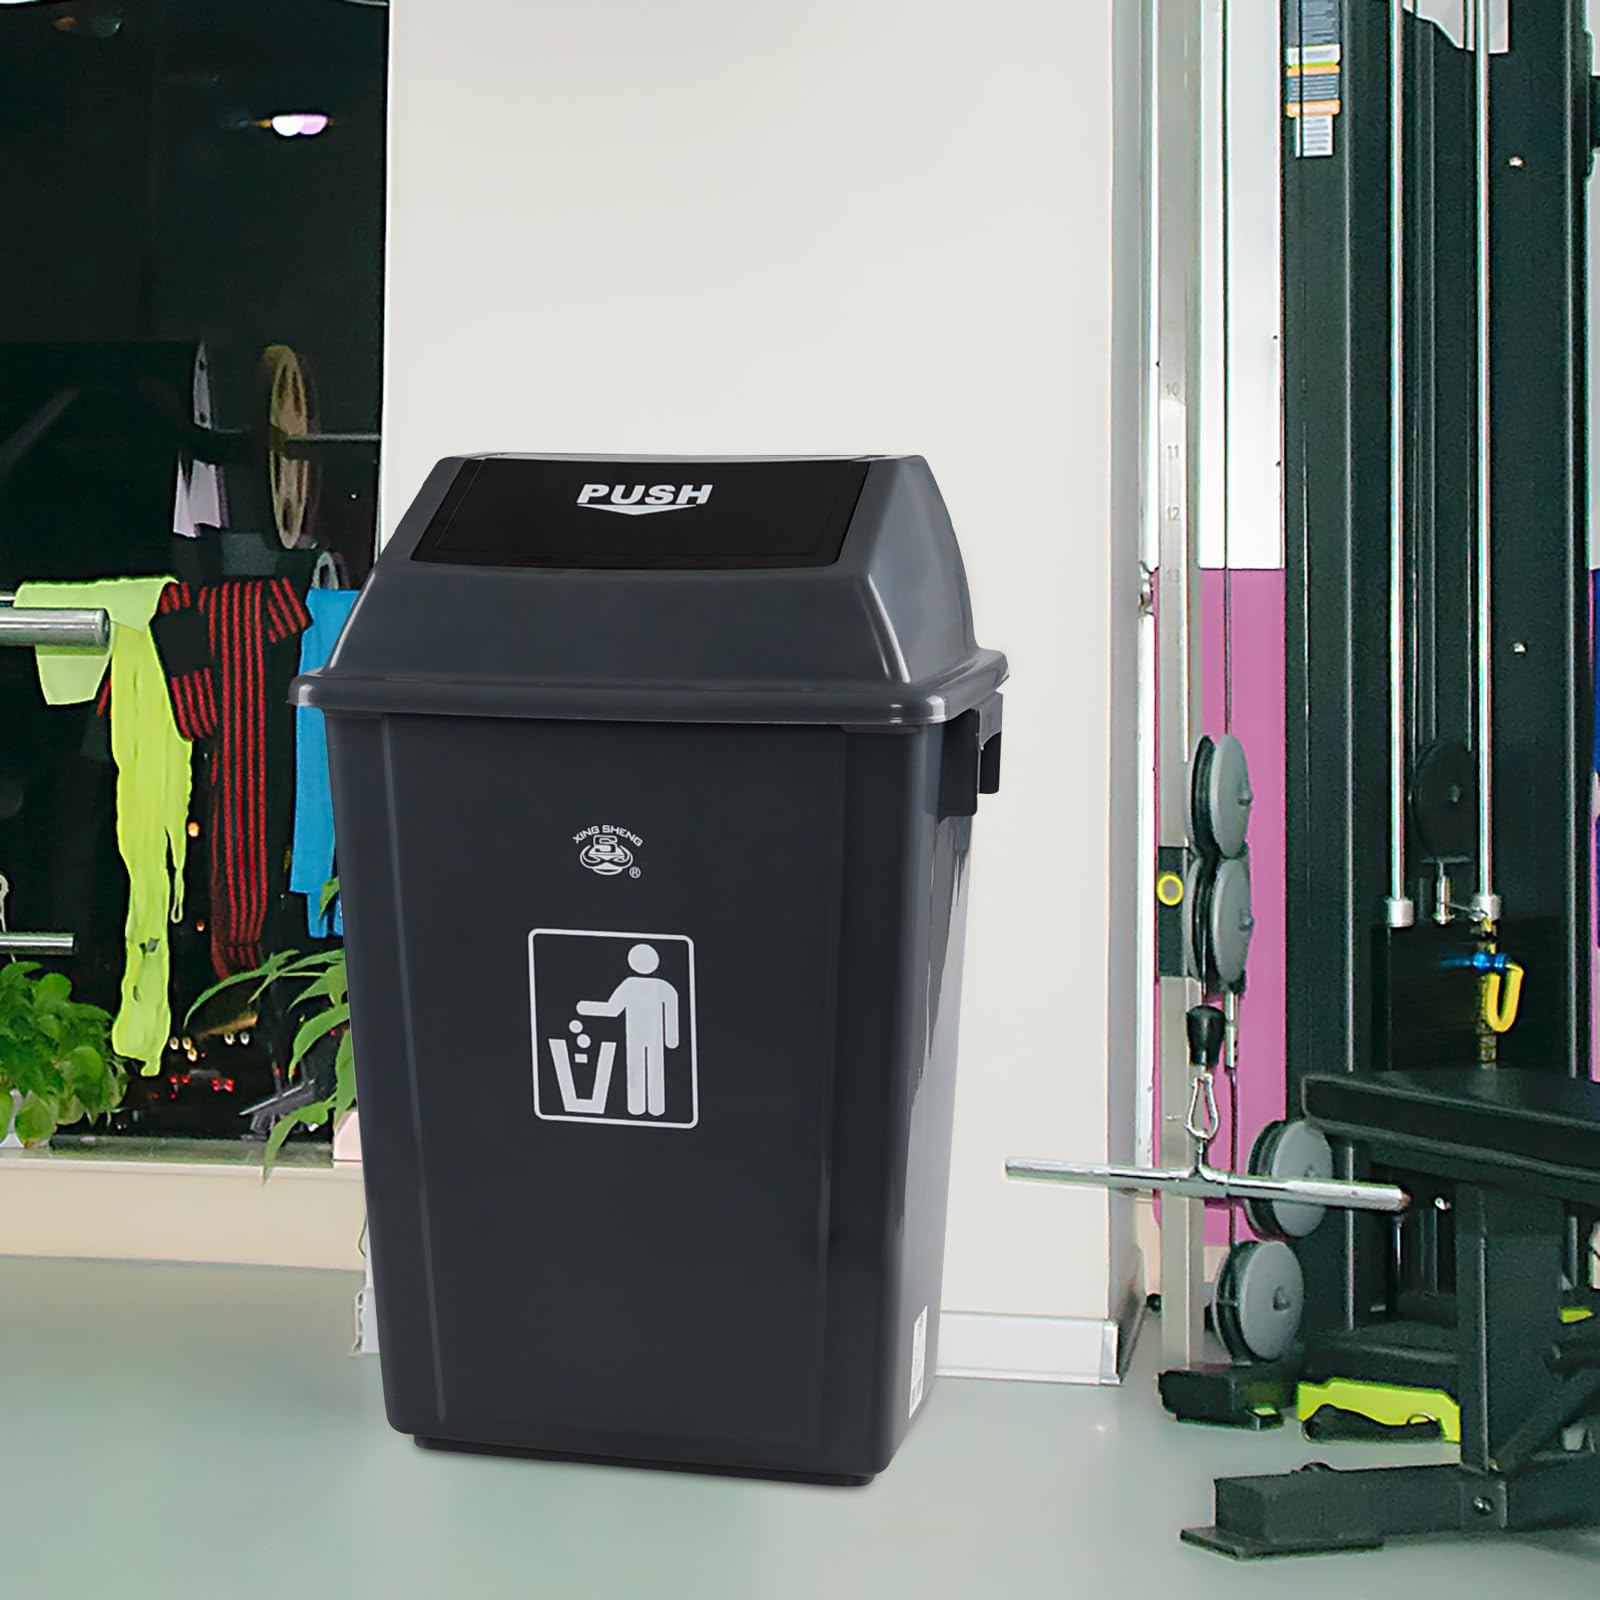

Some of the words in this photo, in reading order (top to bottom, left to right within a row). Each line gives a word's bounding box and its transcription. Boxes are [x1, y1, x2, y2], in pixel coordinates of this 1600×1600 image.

[576, 484, 713, 505] PUSH
[572, 825, 600, 845] XING
[601, 824, 644, 847] SHENG
